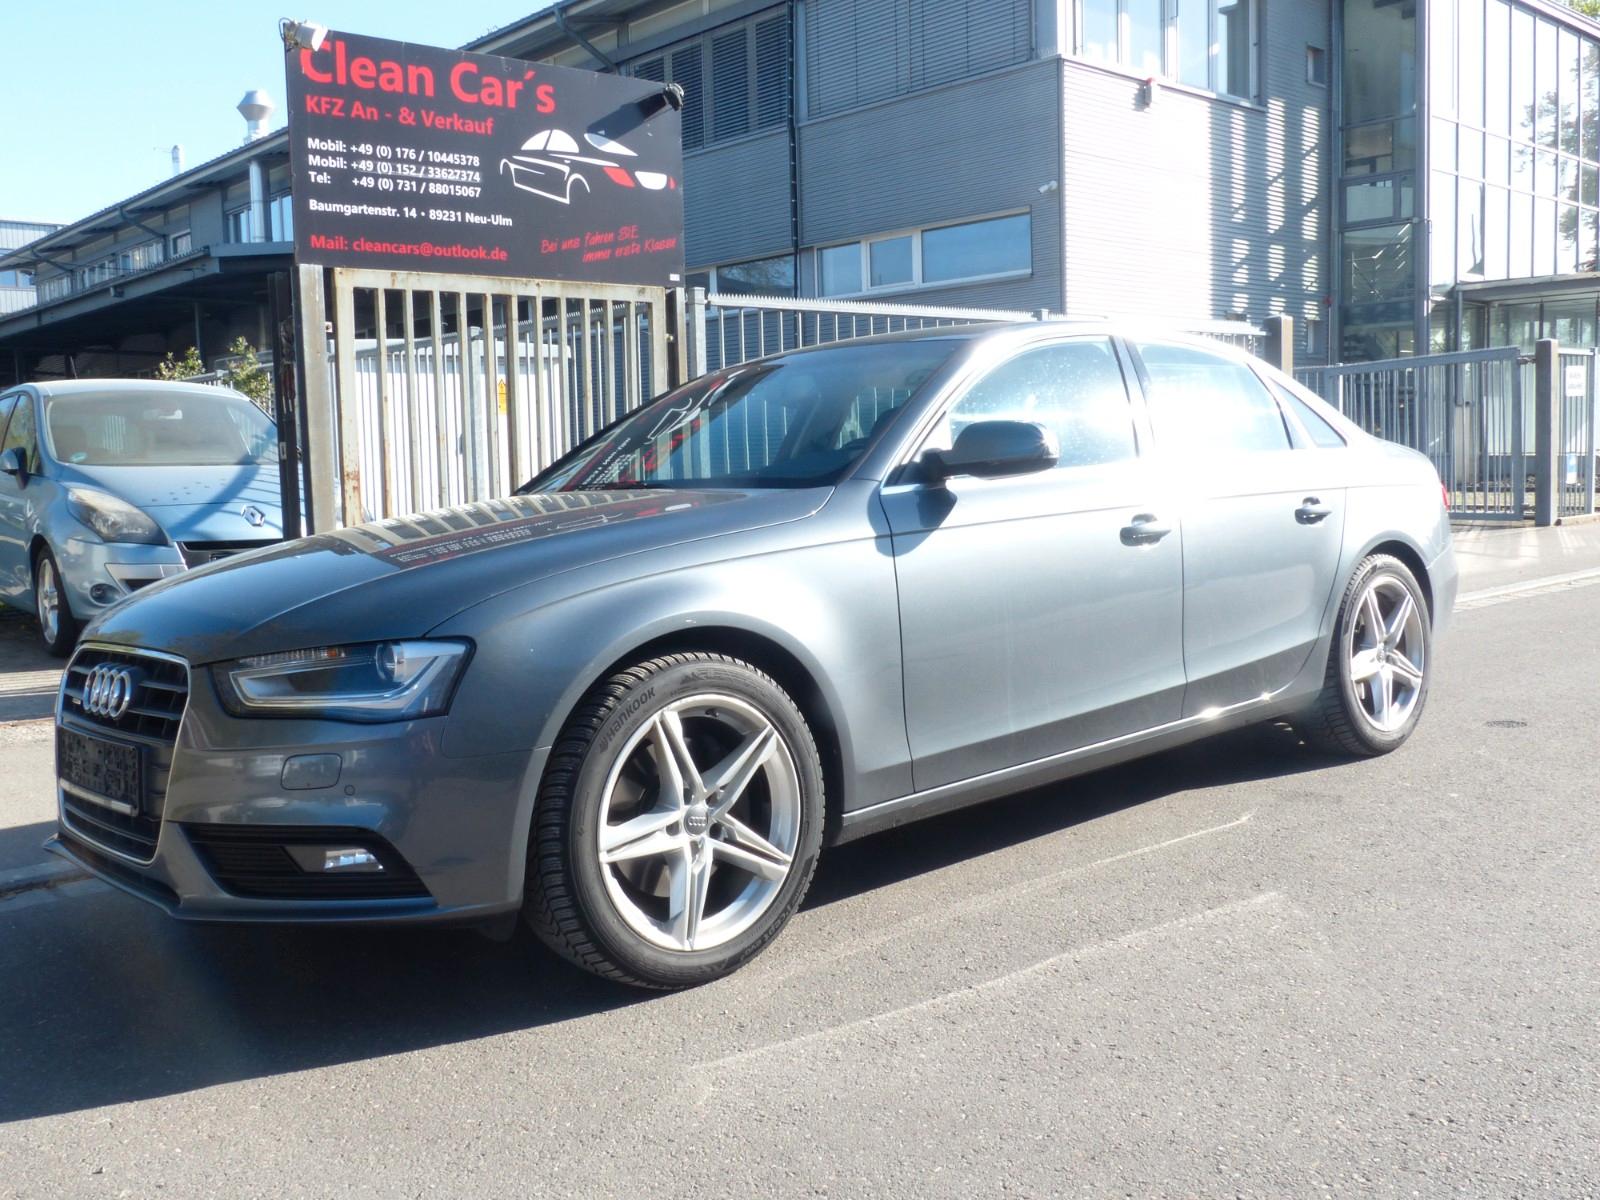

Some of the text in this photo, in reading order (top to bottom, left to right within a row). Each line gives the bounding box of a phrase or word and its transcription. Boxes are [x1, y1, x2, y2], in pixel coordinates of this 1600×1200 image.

[300, 39, 435, 98] Clean
[306, 95, 345, 117] KFZ
[351, 101, 379, 121] An
[398, 105, 417, 125] &
[421, 109, 494, 135] Verkauf
[307, 137, 347, 153] Mobil:
[350, 143, 373, 156] +49
[376, 145, 392, 160] (0)
[395, 147, 417, 160] 176
[427, 150, 480, 167] 10445378
[308, 154, 348, 170] Mobil:
[350, 160, 374, 172] +49
[377, 161, 393, 175] (0)
[396, 163, 417, 176] 152
[427, 166, 481, 183] 33627374
[308, 171, 332, 185] Tel:
[352, 176, 375, 188] +49
[378, 177, 394, 192] (0)
[396, 179, 417, 192] 731
[428, 182, 482, 198] 88015067
[309, 199, 401, 217] Baumgartenstr.
[403, 206, 417, 219] 14
[428, 208, 462, 222] 89231
[465, 211, 513, 227] Neu-Ulm
[309, 234, 509, 261] Mail: cleancars@outlook.de
